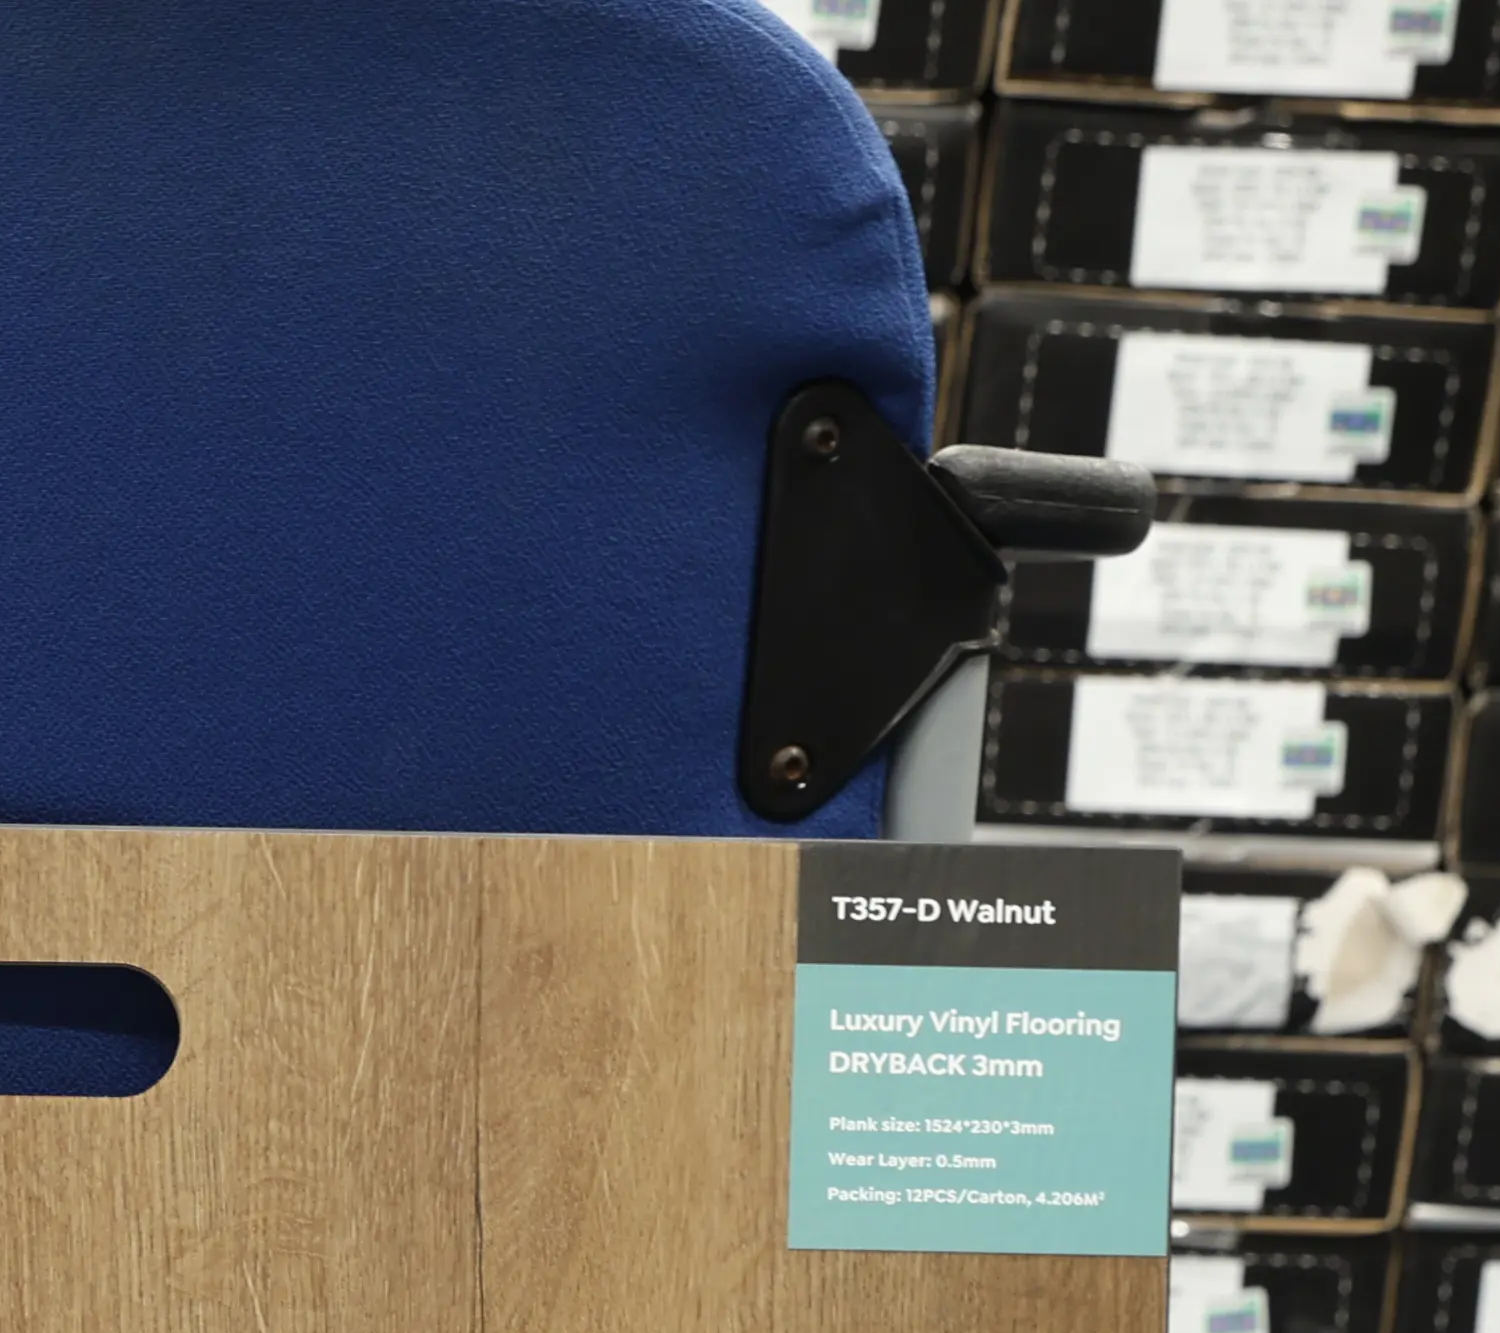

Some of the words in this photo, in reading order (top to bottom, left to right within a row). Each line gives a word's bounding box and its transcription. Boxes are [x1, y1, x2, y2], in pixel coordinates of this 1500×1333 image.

[832, 896, 941, 922] T357-D
[946, 898, 1057, 925] Walnut
[830, 1008, 924, 1038] Luxury
[929, 1008, 999, 1039] Vinyl
[1006, 1010, 1121, 1042] Flooring
[829, 1051, 967, 1076] DRYBACK
[971, 1054, 1044, 1077] 3mm
[829, 1116, 878, 1132] Plank
[881, 1116, 921, 1133] size:
[828, 1152, 875, 1167] Wear
[878, 1153, 932, 1171] Layer:
[935, 1154, 997, 1169] 0.5mm
[827, 1186, 902, 1205] Packing:
[905, 1188, 1032, 1207] 12PCS/Carton,
